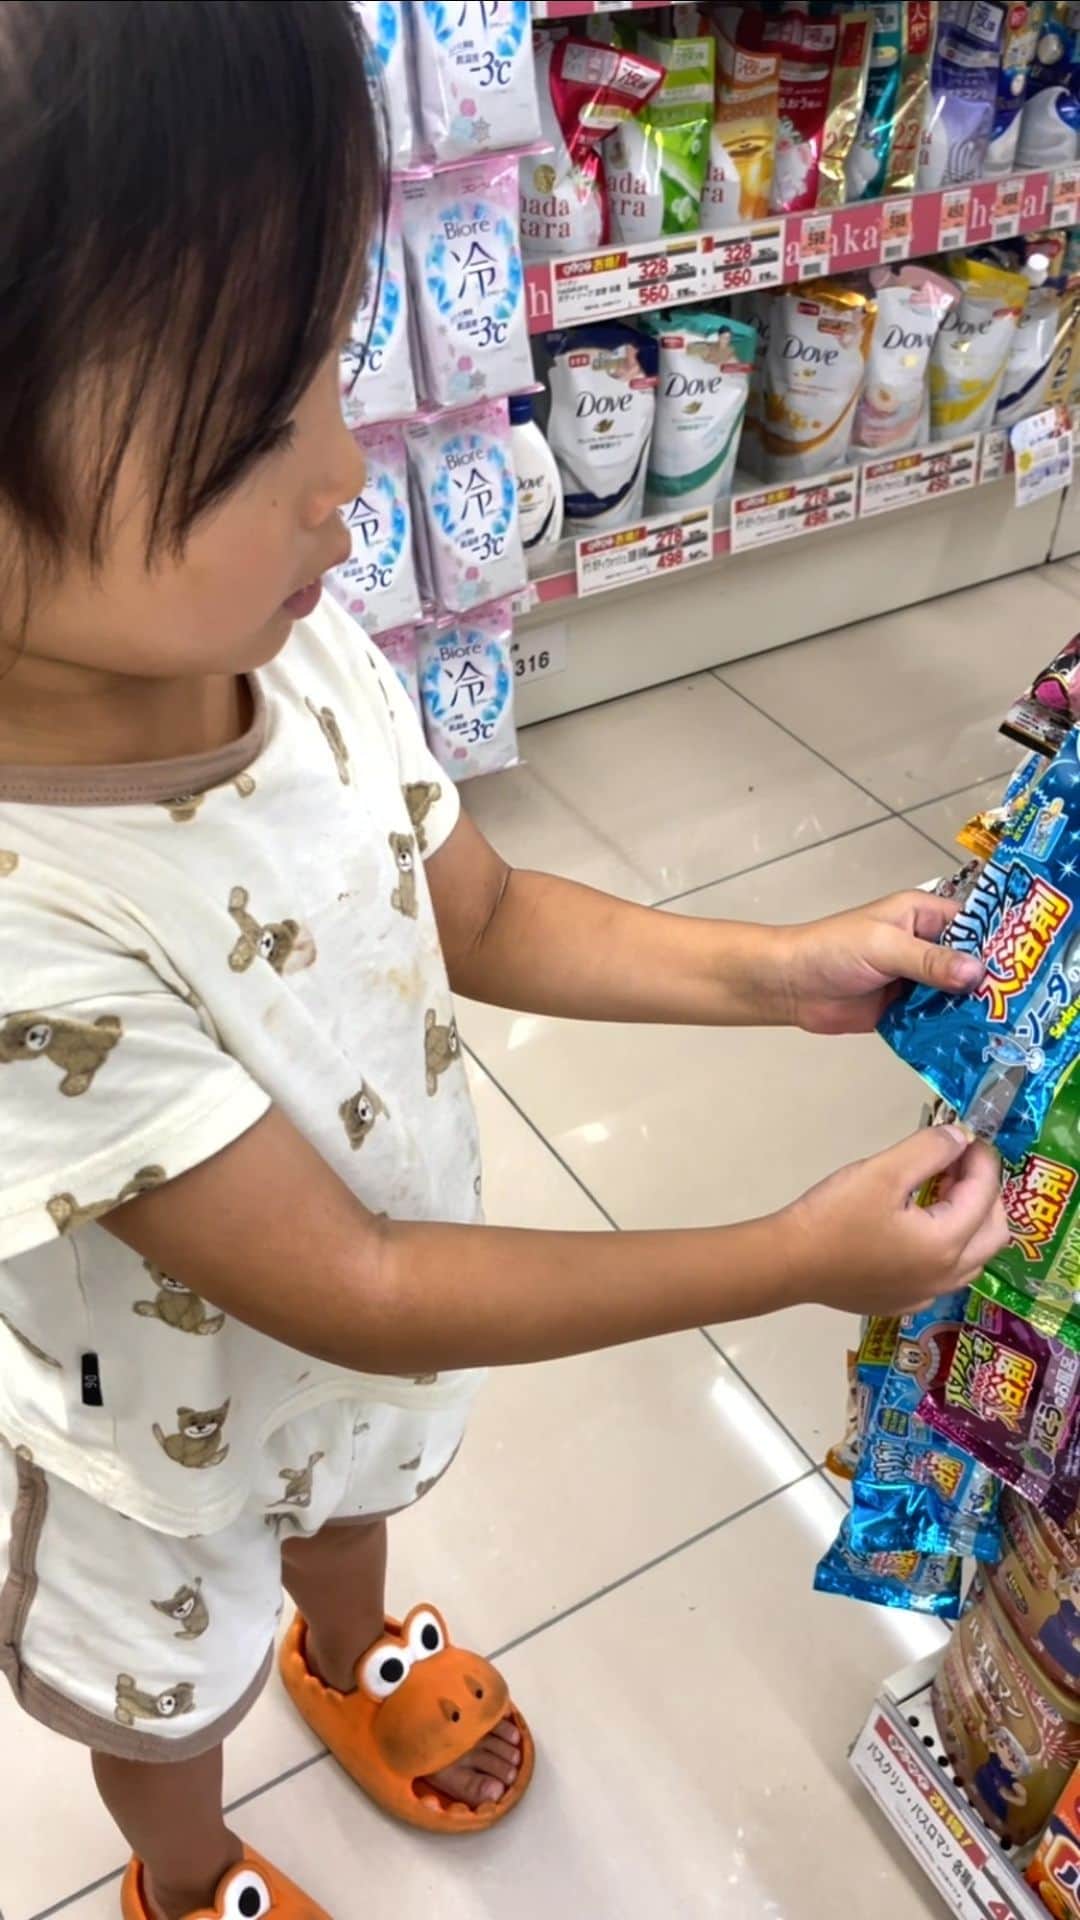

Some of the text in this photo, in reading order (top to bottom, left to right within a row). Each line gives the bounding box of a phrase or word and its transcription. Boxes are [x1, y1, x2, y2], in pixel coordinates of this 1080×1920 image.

[444, 219, 491, 241] Biore
[723, 244, 753, 264] 328
[450, 240, 497, 299] 冷
[638, 258, 668, 281] 328
[722, 268, 752, 288] 560
[638, 283, 669, 305] 560
[782, 336, 839, 366] Dove
[664, 372, 722, 398] Dove
[576, 390, 634, 418] Dove
[445, 449, 485, 471] Biore
[453, 467, 492, 521] 冷
[657, 549, 683, 568] 498
[439, 644, 482, 662] Biore
[514, 651, 550, 677] 316
[443, 660, 488, 708] 冷
[974, 878, 1072, 1022] 入浴剤
[1006, 1155, 1077, 1261] 入浴剤
